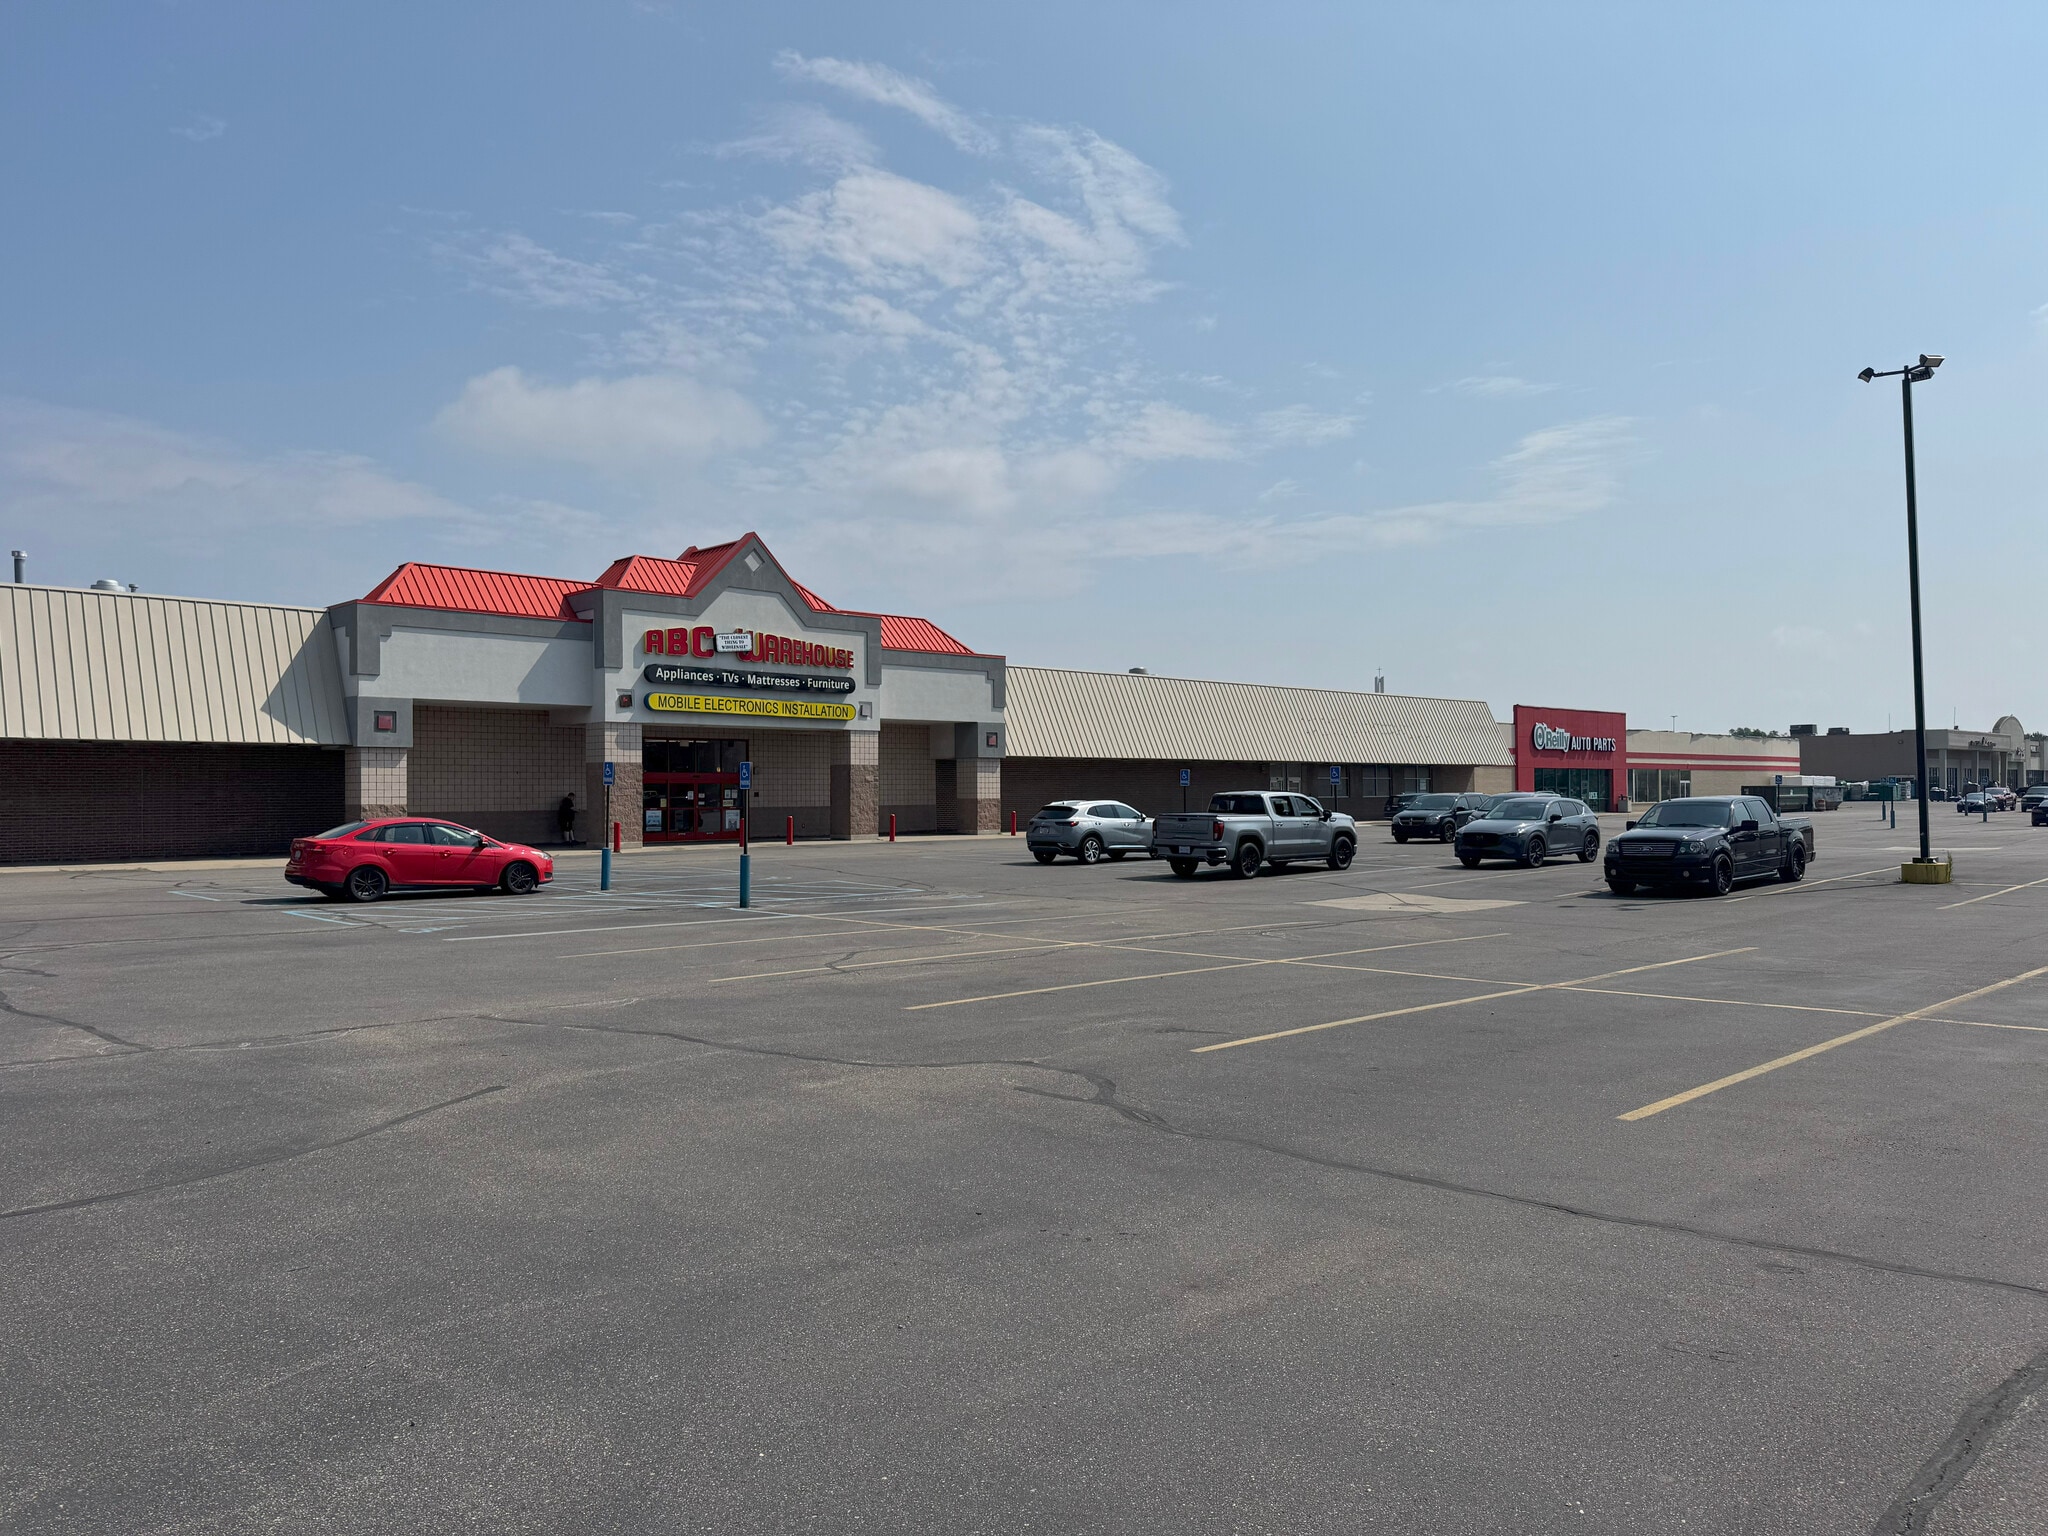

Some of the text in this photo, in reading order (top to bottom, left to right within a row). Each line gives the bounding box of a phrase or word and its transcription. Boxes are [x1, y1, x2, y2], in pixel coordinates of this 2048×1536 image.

[644, 625, 714, 659] ABC
[655, 667, 850, 690] Appliances TVs Mattresses Furniture
[658, 696, 849, 718] MOBILE ELECTRONICS INSTALLATION
[1534, 722, 1617, 753] O'Reilly AUTO PARTS
